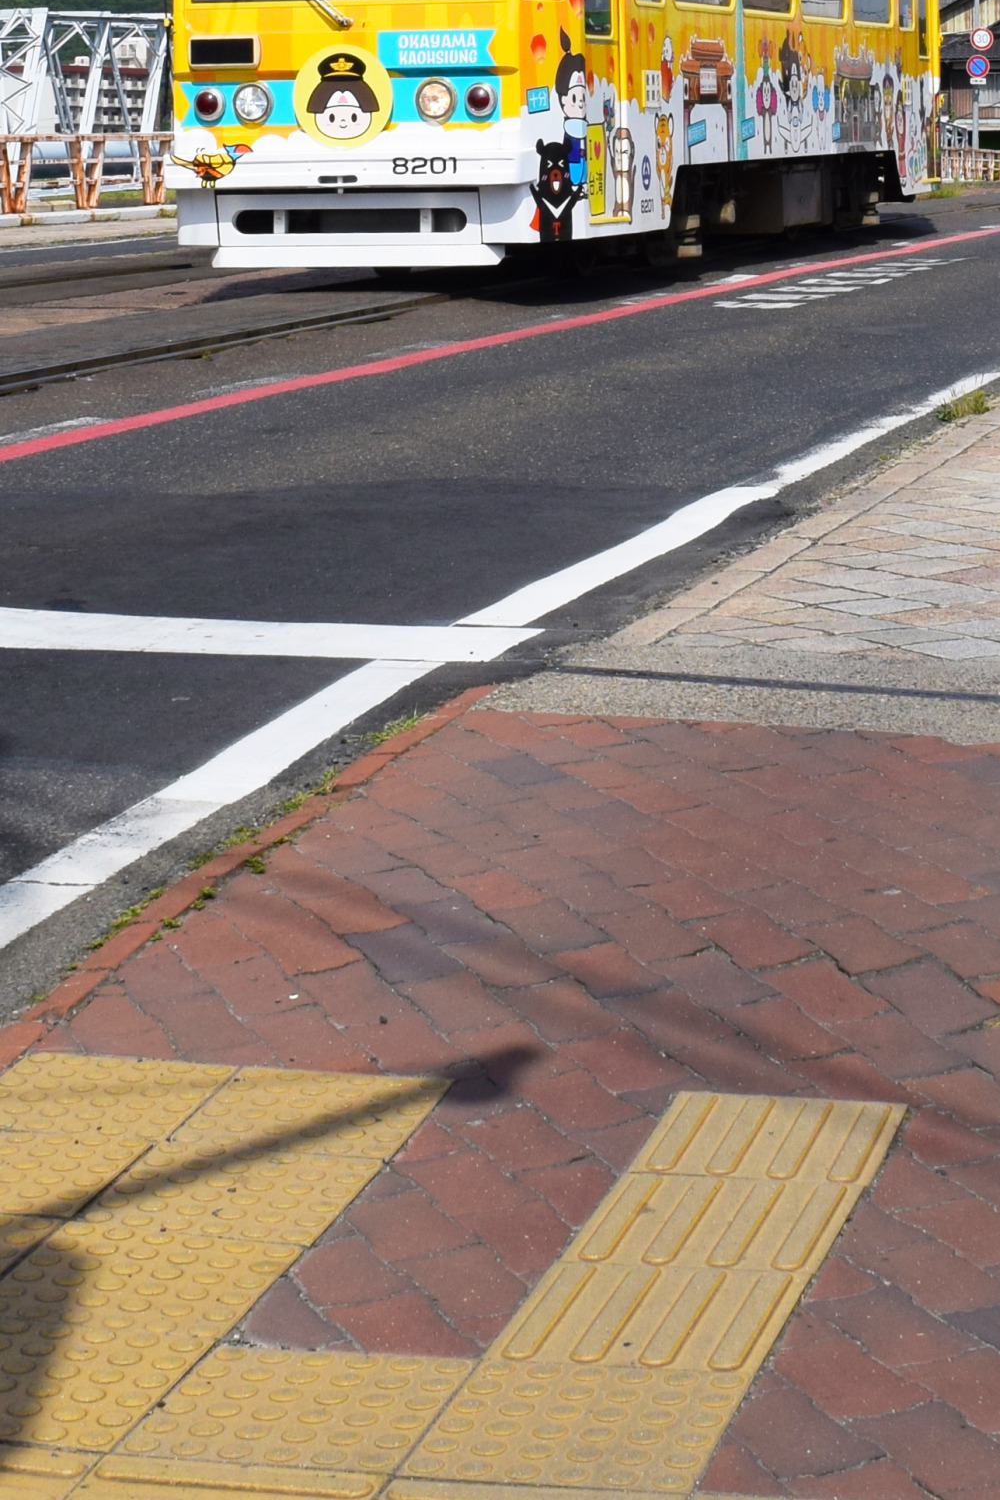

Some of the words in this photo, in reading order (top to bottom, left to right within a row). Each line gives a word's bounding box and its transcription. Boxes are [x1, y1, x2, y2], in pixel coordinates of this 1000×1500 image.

[398, 33, 477, 49] OKAYAMA
[976, 33, 989, 44] 30
[399, 49, 478, 66] KAOHSIUNG
[392, 156, 457, 175] 8201
[641, 199, 655, 214] 8201
